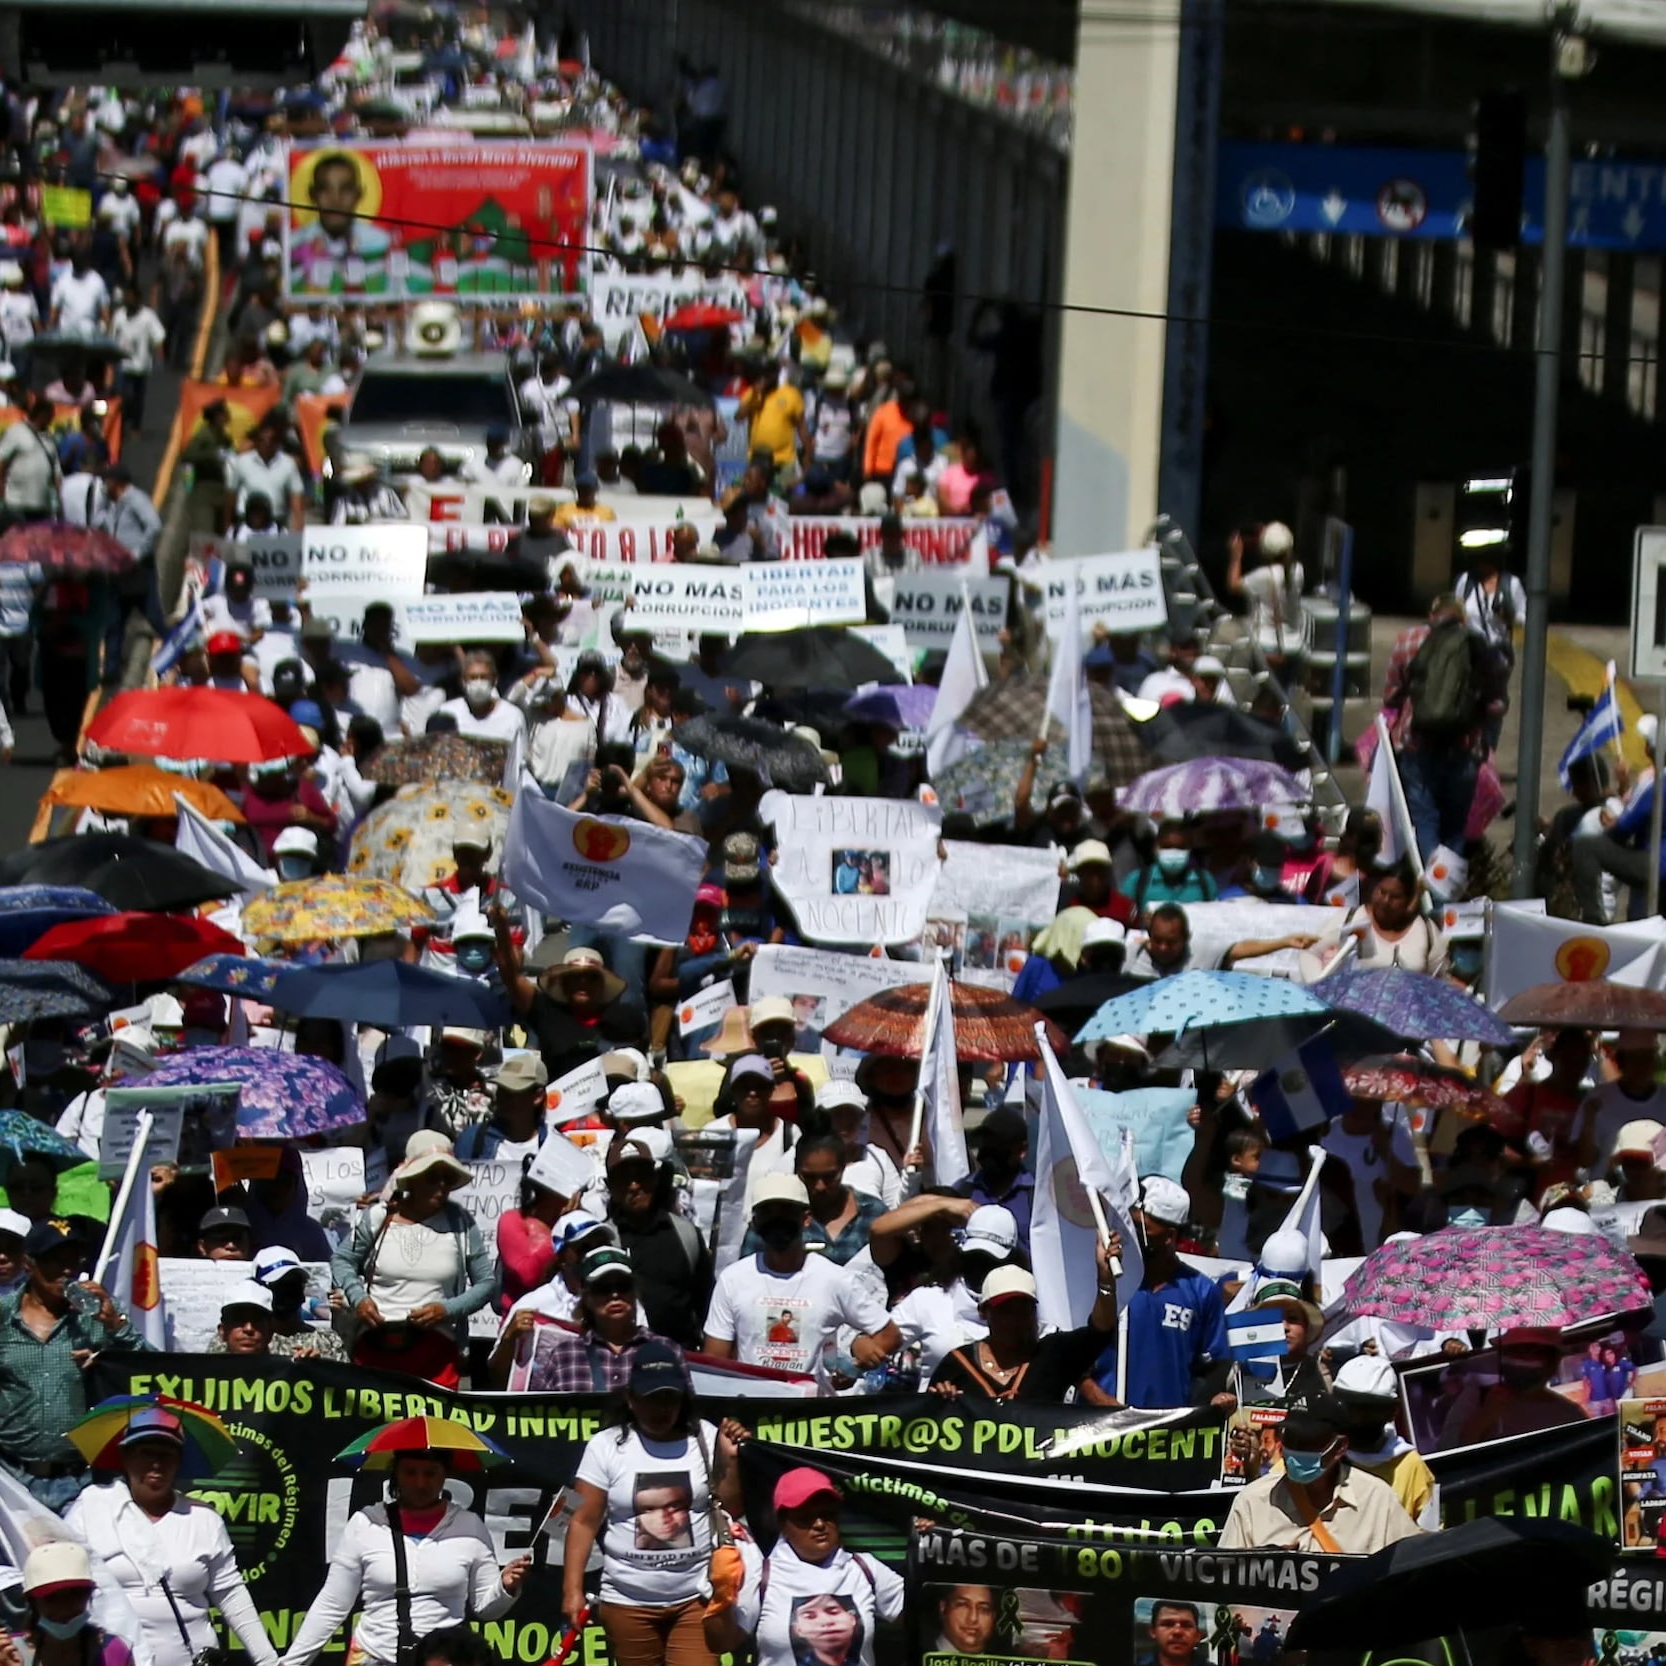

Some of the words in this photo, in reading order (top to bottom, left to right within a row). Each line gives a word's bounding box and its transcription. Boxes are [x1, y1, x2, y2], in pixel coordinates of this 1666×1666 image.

[307, 543, 347, 563] NO
[748, 564, 856, 582] LIBERTAD
[1094, 570, 1155, 595] MÁS
[634, 580, 674, 598] NO
[685, 577, 743, 601] MÁS
[756, 584, 803, 598] PARA
[810, 583, 850, 597] LOS
[405, 603, 448, 615] NO
[630, 603, 743, 620] CORRUPCIÓN
[894, 593, 935, 614] NO
[326, 1159, 362, 1182] LOS
[324, 1386, 496, 1433] LIBERTAD
[756, 1414, 964, 1455] NUESTR@S
[973, 1421, 1039, 1460] PDL
[270, 1448, 293, 1473] del
[185, 1489, 282, 1524] OVIR
[274, 1473, 301, 1549] Régimen
[917, 1528, 987, 1568] MÁS
[996, 1543, 1038, 1572] DE
[1077, 1547, 1124, 1579] 80
[1159, 1549, 1320, 1592] VÍCTIMAS
